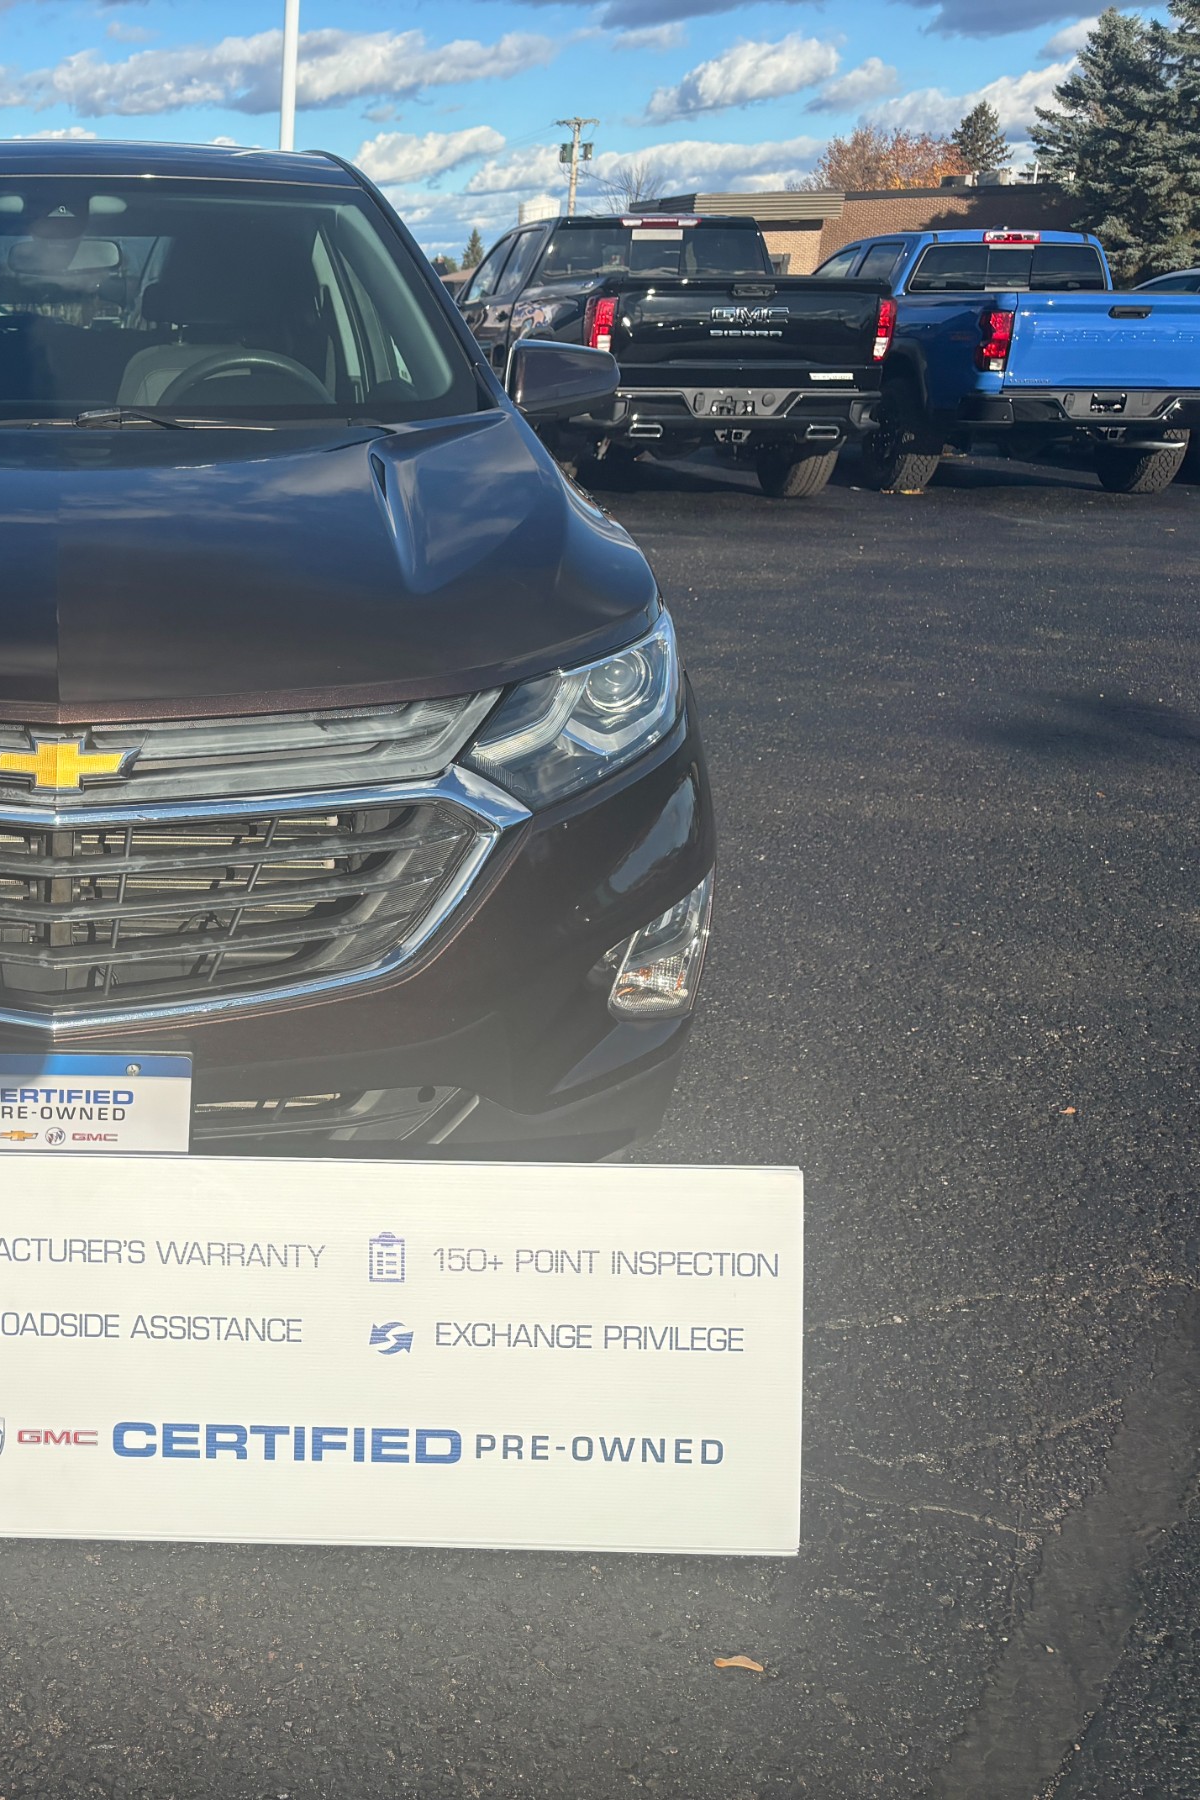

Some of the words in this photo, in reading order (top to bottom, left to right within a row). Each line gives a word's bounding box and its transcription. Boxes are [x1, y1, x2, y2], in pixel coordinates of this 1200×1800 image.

[711, 306, 790, 326] GMC
[709, 329, 783, 337] SIERRA
[71, 1132, 119, 1142] GMC
[156, 1240, 327, 1268] WARRANTY
[432, 1247, 504, 1274] 150+
[515, 1249, 601, 1275] POINT
[611, 1250, 779, 1278] INSPECTION
[130, 1315, 303, 1343] ASSISTANCE
[435, 1322, 593, 1349] EXCHANGE
[604, 1325, 744, 1352] PRIVILEGE
[17, 1428, 99, 1446] GMC
[112, 1421, 462, 1464] CERTIFIED
[475, 1434, 725, 1466] PRE-OWNED
